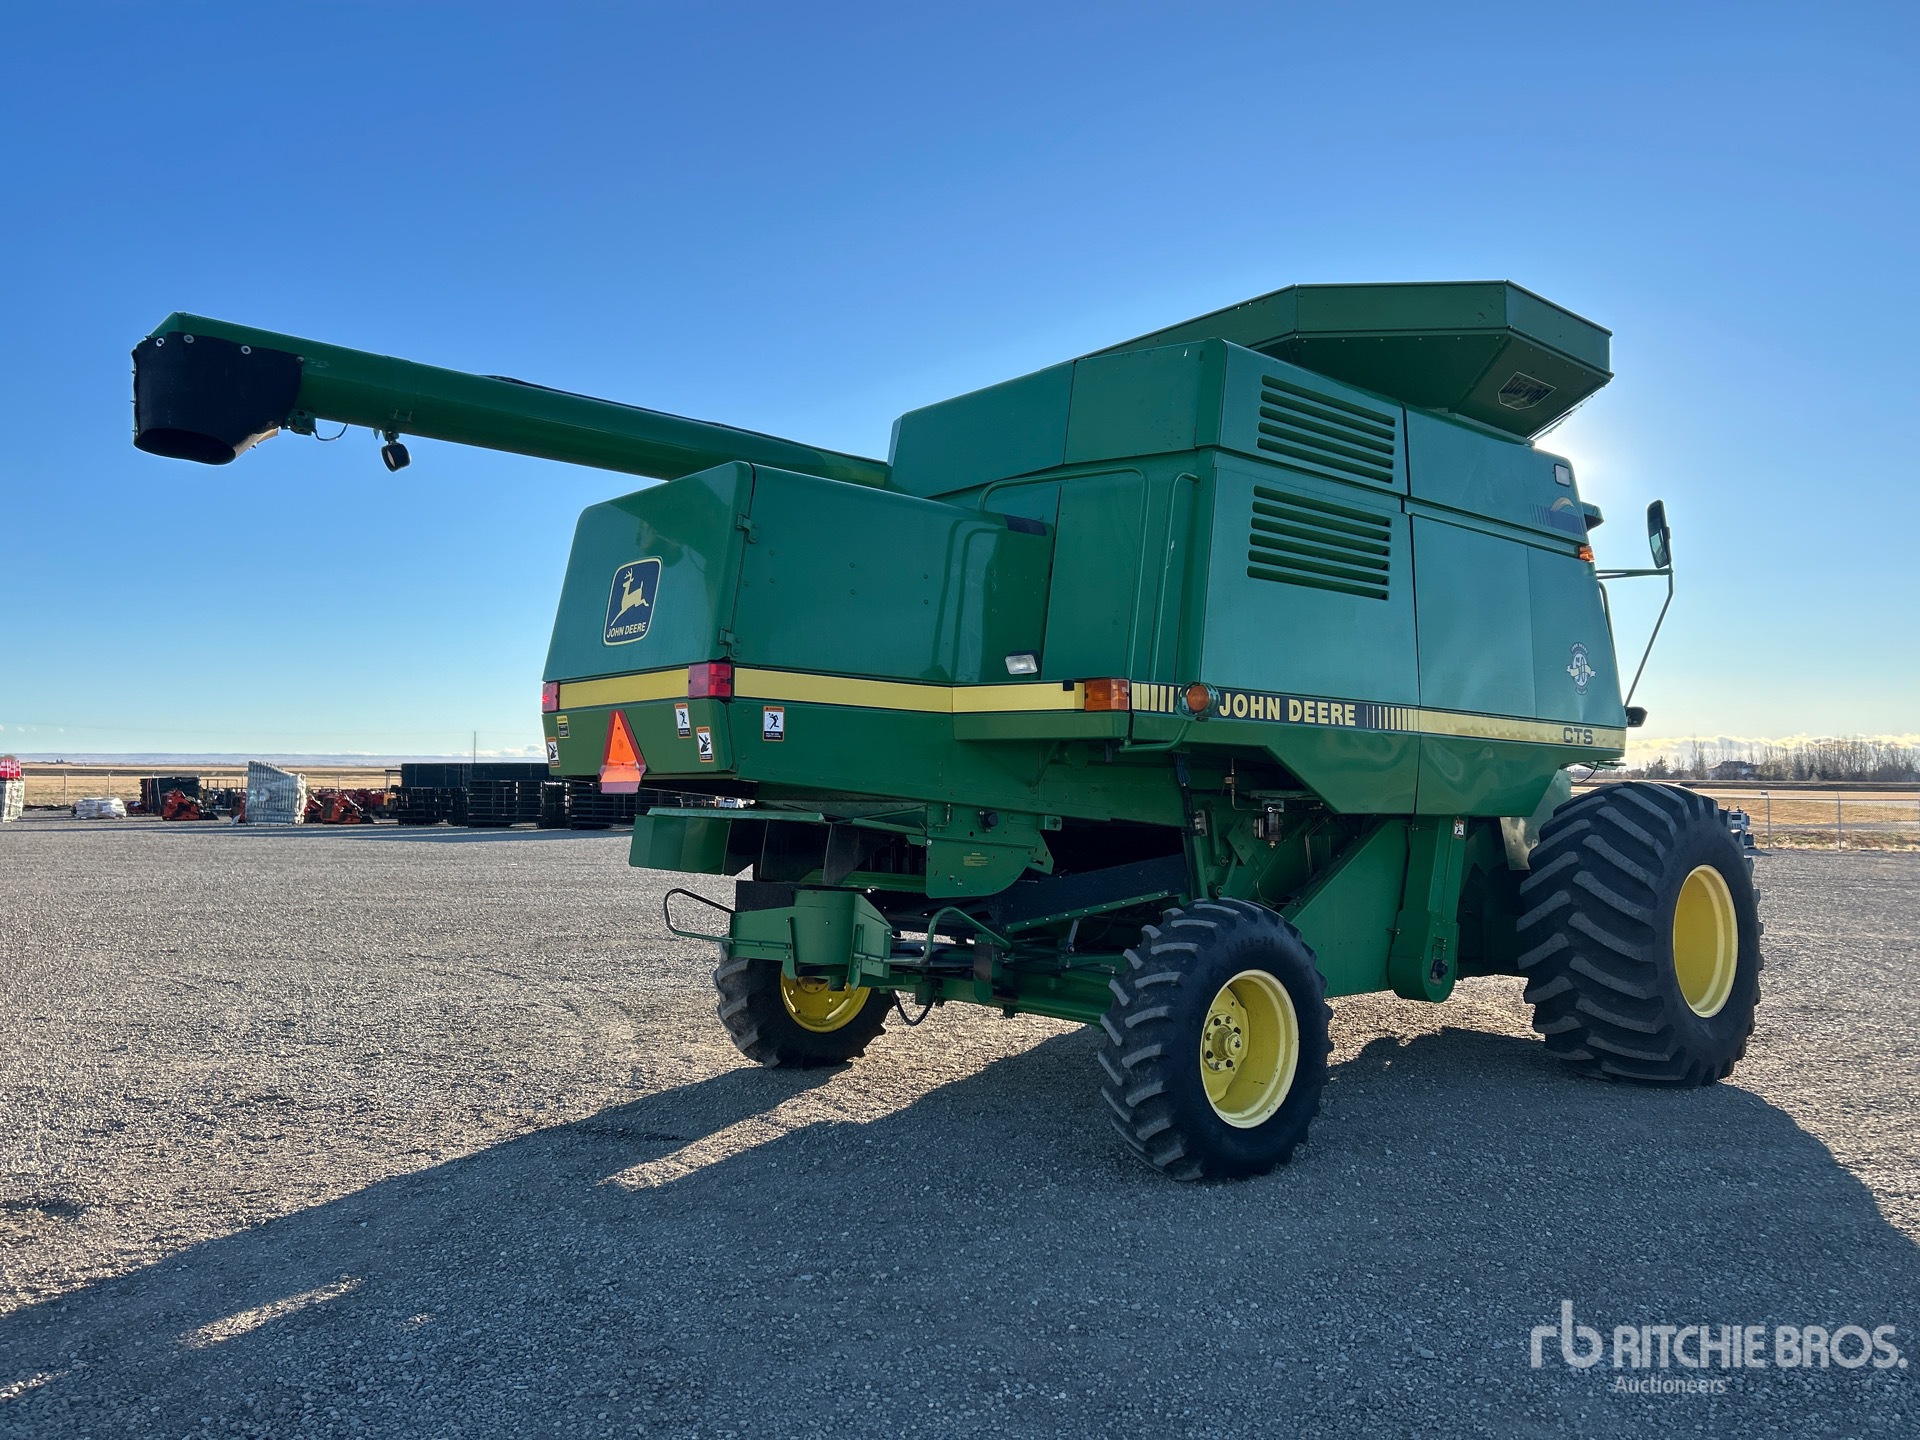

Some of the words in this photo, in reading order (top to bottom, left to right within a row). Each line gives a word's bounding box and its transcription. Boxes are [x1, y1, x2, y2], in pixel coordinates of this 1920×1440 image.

[606, 626, 625, 639] JOHN
[624, 622, 647, 635] DEERE
[1219, 692, 1280, 720] JOHN
[1288, 699, 1356, 726] DEERE
[1563, 727, 1593, 745] CTS
